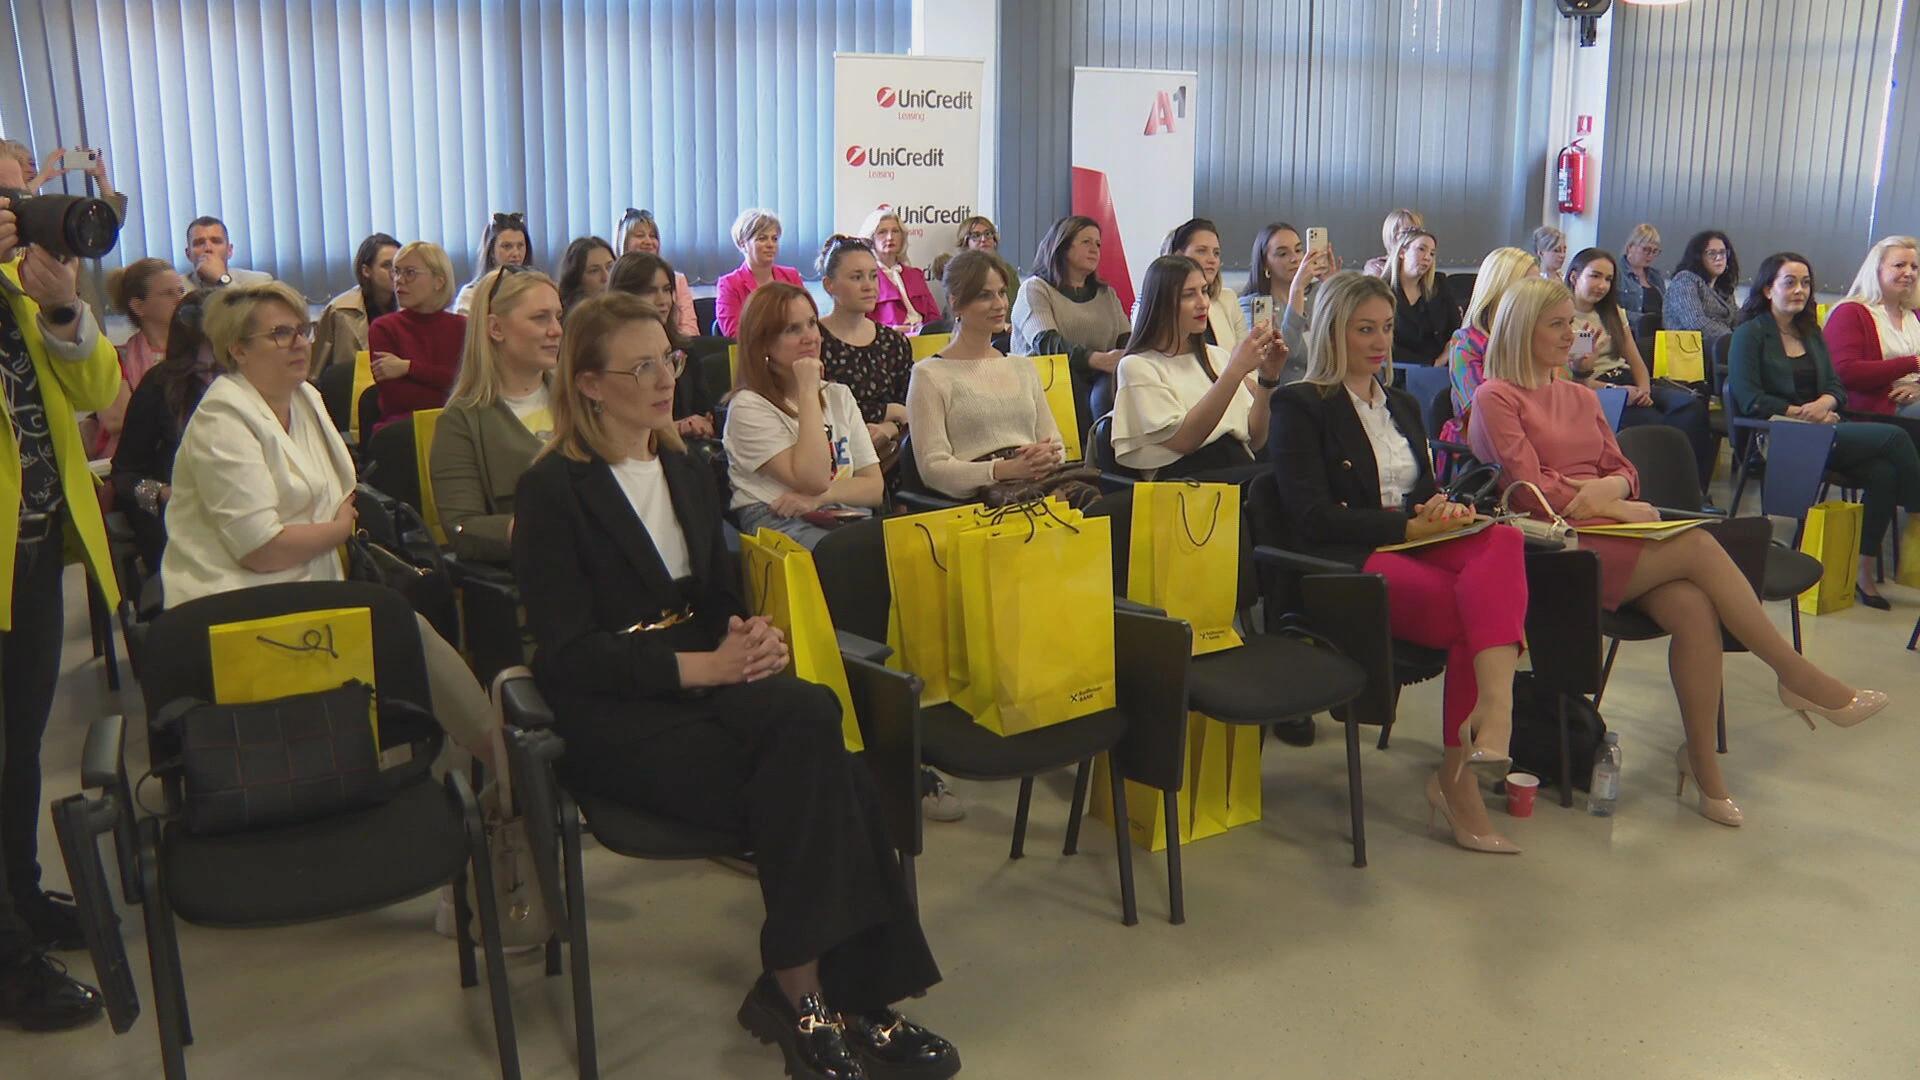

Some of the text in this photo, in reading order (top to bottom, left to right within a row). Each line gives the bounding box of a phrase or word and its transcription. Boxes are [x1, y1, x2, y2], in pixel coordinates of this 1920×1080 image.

[898, 89, 973, 109] UniCredit
[1144, 85, 1186, 136] A1
[869, 147, 944, 167] UniCredit
[869, 169, 895, 180] Leasing
